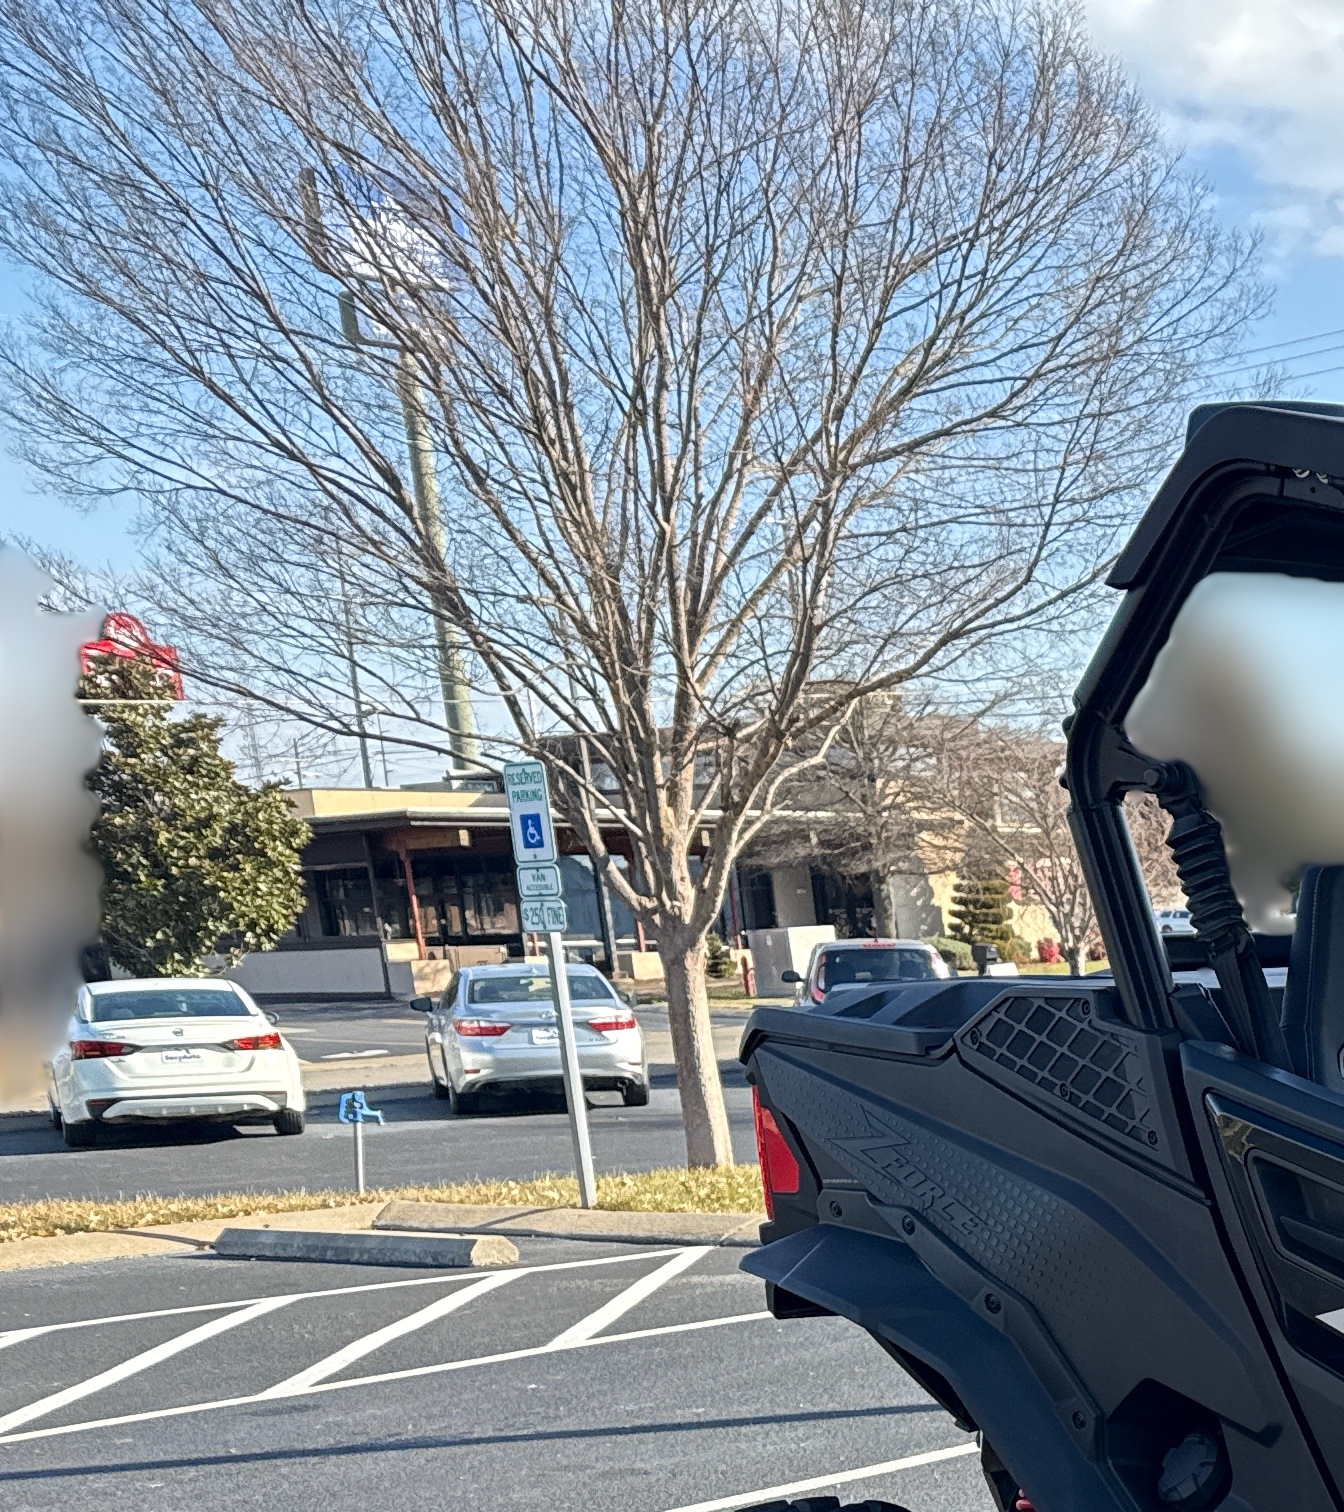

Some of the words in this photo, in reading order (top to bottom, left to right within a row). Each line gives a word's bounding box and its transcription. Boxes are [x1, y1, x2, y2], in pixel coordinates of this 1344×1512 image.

[507, 770, 543, 786] RESERVED
[512, 788, 543, 803] PARKING
[531, 872, 546, 882] VAN
